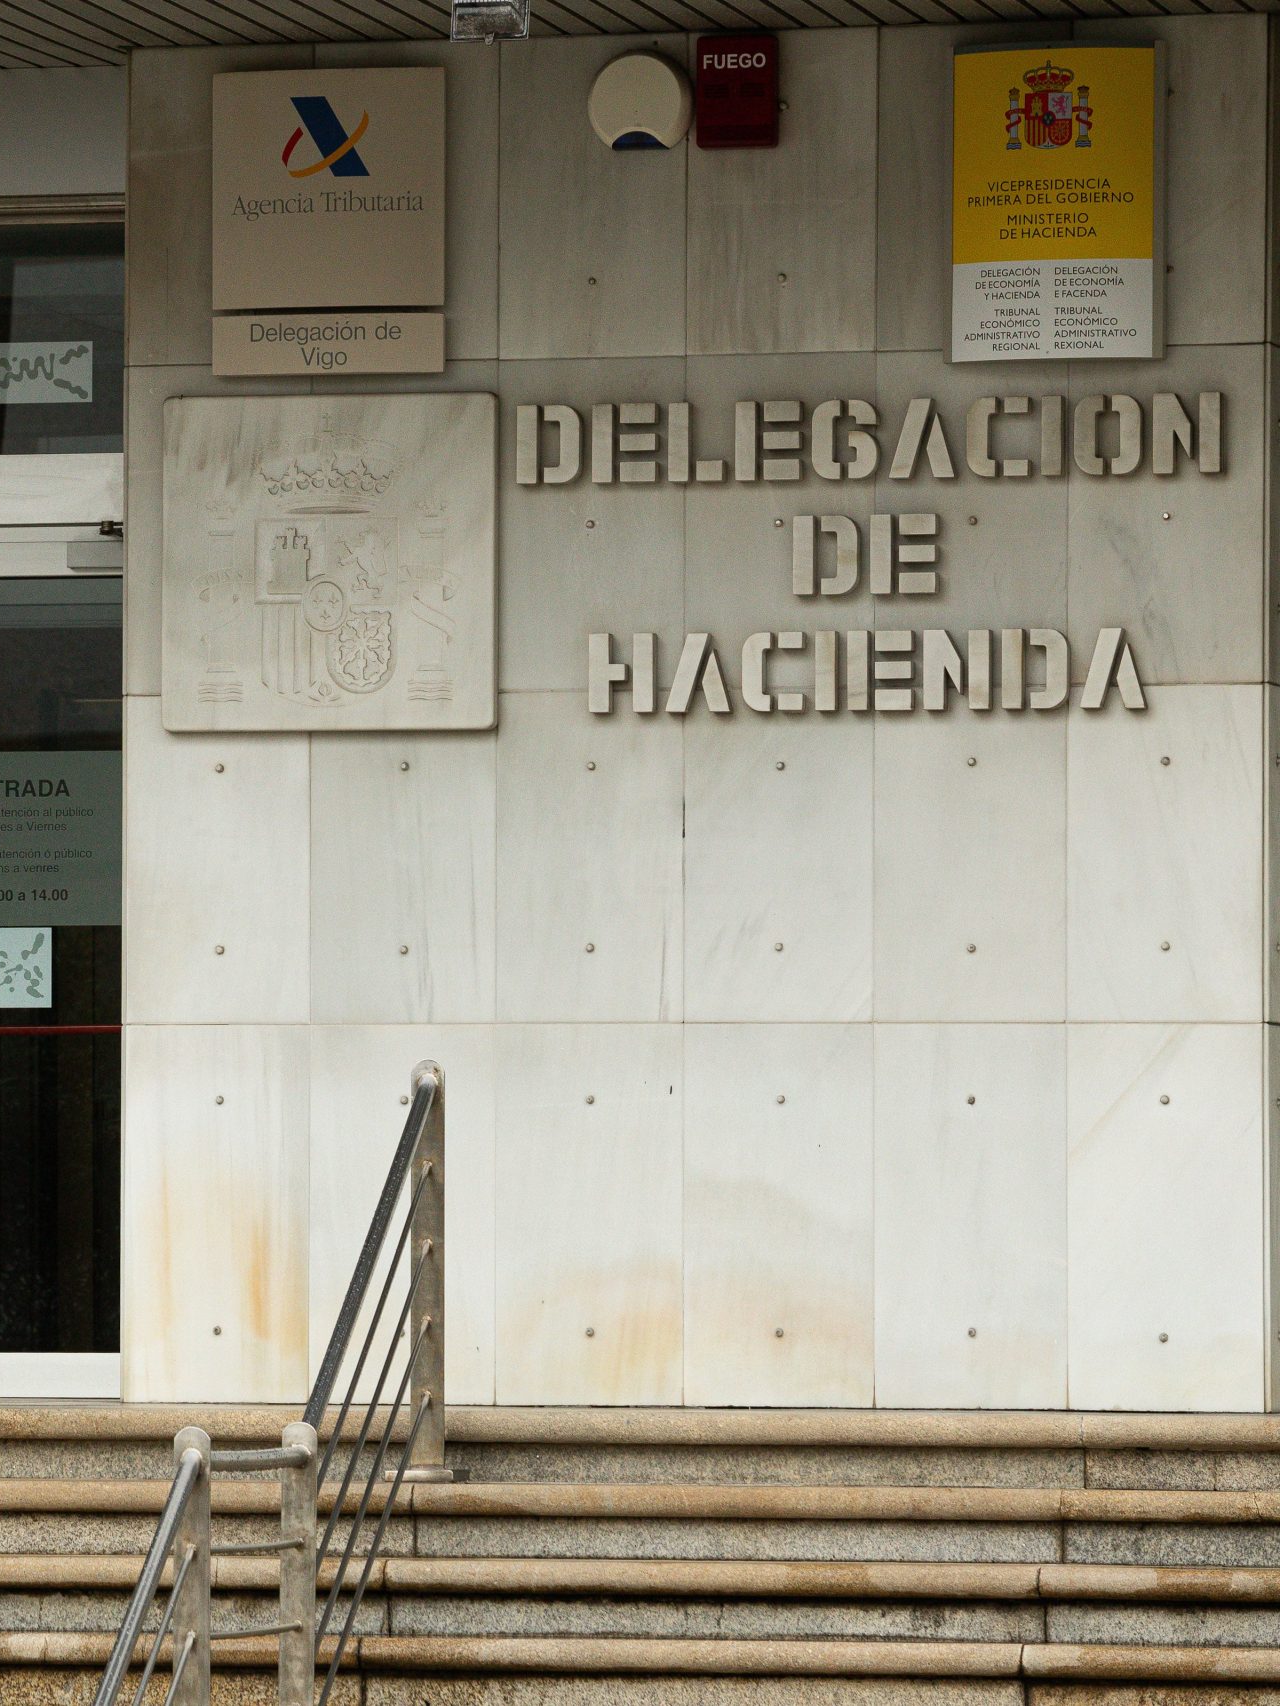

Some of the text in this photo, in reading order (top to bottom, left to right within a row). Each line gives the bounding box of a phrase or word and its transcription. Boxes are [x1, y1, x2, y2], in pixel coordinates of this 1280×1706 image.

[703, 53, 766, 69] FUEGO
[987, 178, 1111, 192] VICEPRESIDENCIA
[231, 190, 424, 221] Agencia Tributaria
[967, 192, 1134, 208] PRIMERA DEL GOBIERNO
[1007, 212, 1089, 226] MINISTERIO
[999, 226, 1097, 240] DE HACIENDA
[980, 266, 1040, 278] DELEGACIÓN
[1054, 265, 1118, 275] DELEGACIÓN
[975, 279, 1040, 290] DE ECONOMÍA
[1054, 276, 1124, 287] DE ECONOMÍA
[984, 291, 1040, 301] Y HACIENDA
[1054, 289, 1107, 298] E FACENDA
[994, 308, 1040, 317] TRIBUNAL
[1054, 306, 1103, 315] TRIBUNAL
[980, 318, 1040, 329] ECONÓMICO
[1054, 315, 1118, 327] ECONÓMICO
[250, 321, 402, 345] Delegación de
[964, 331, 1040, 341] ADMINISTRATIVO
[1054, 328, 1137, 338] ADMINISTRATIVO
[992, 342, 1040, 351] REGIONAL
[1054, 340, 1104, 349] REXIONAL
[301, 347, 348, 370] Vigo
[516, 392, 1222, 484] DELEGACION
[792, 513, 940, 596] DE
[588, 627, 1148, 714] HACIENDA
[43, 807, 52, 817] al
[55, 807, 94, 819] público
[26, 821, 68, 831] Viernes
[54, 849, 93, 860] público
[13, 865, 20, 873] a
[23, 865, 60, 873] venres
[17, 891, 26, 901] a
[31, 889, 69, 901] 14.00
